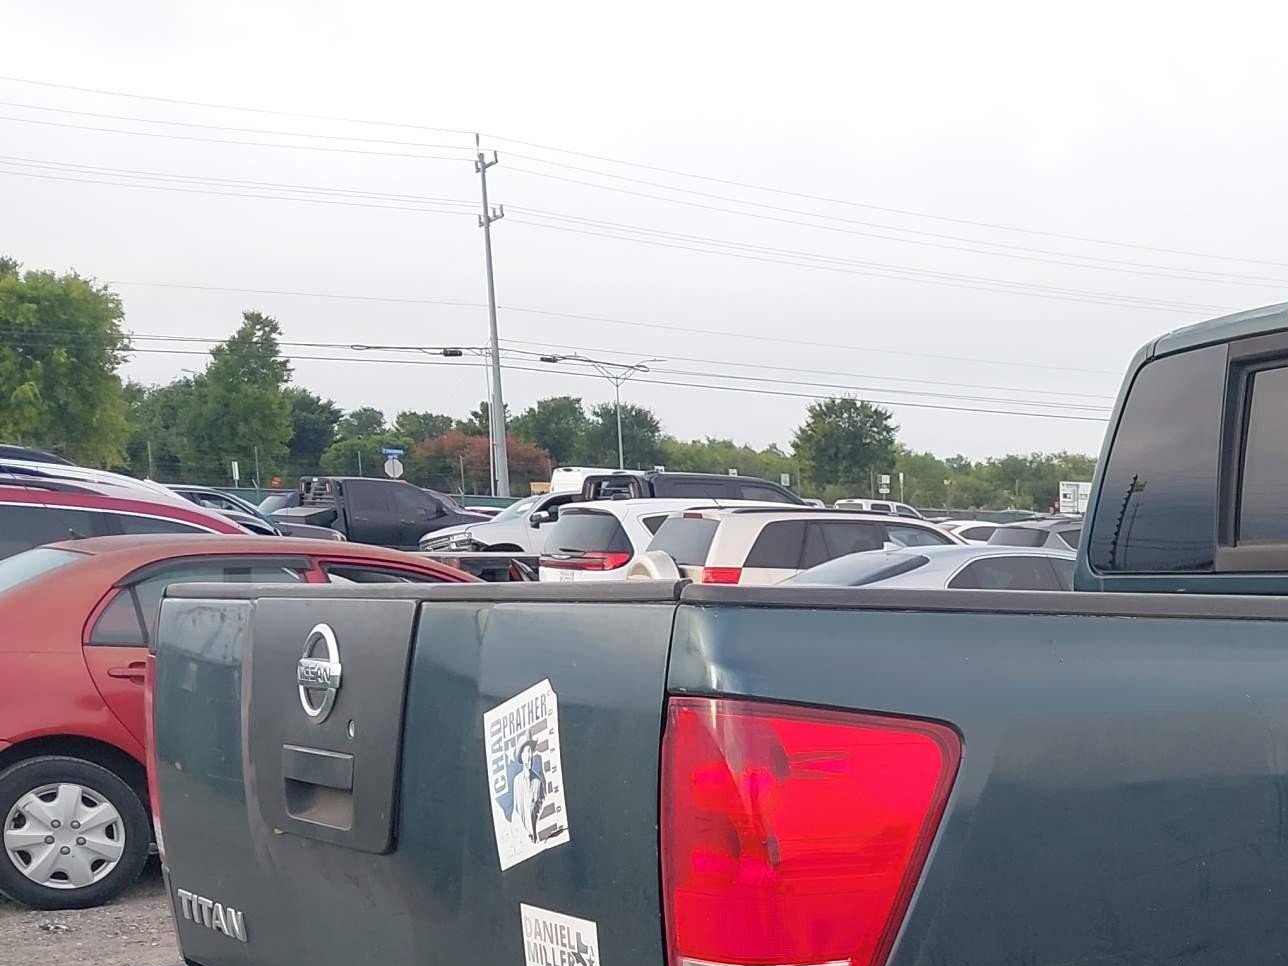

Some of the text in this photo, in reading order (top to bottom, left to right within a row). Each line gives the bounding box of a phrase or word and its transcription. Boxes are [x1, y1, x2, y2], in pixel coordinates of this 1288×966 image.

[502, 693, 548, 739] PRATHER
[490, 717, 507, 794] CHAD
[177, 888, 248, 942] TITAN
[525, 916, 576, 950] DANIEL
